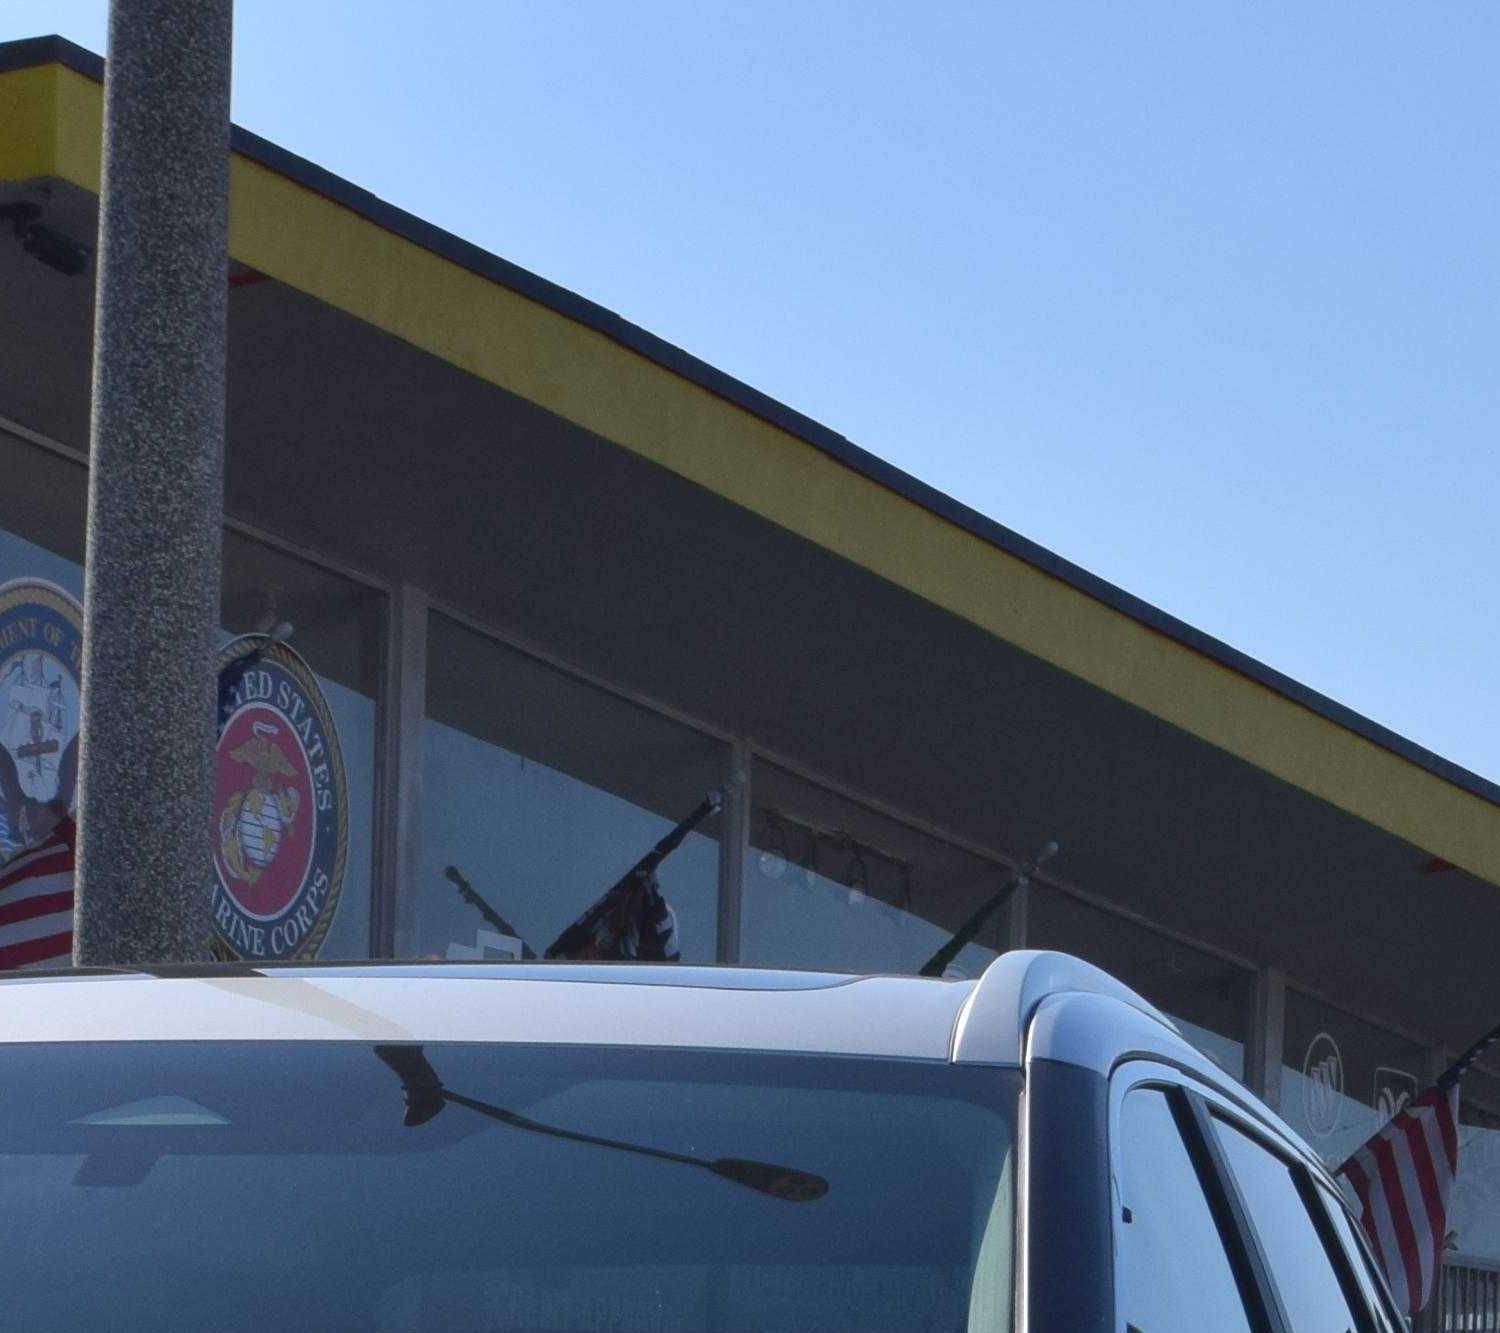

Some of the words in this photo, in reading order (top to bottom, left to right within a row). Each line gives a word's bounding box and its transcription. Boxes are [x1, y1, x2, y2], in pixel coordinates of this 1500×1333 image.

[277, 681, 333, 811] STATES
[211, 883, 266, 957] RINE
[271, 867, 329, 955] CORPS
